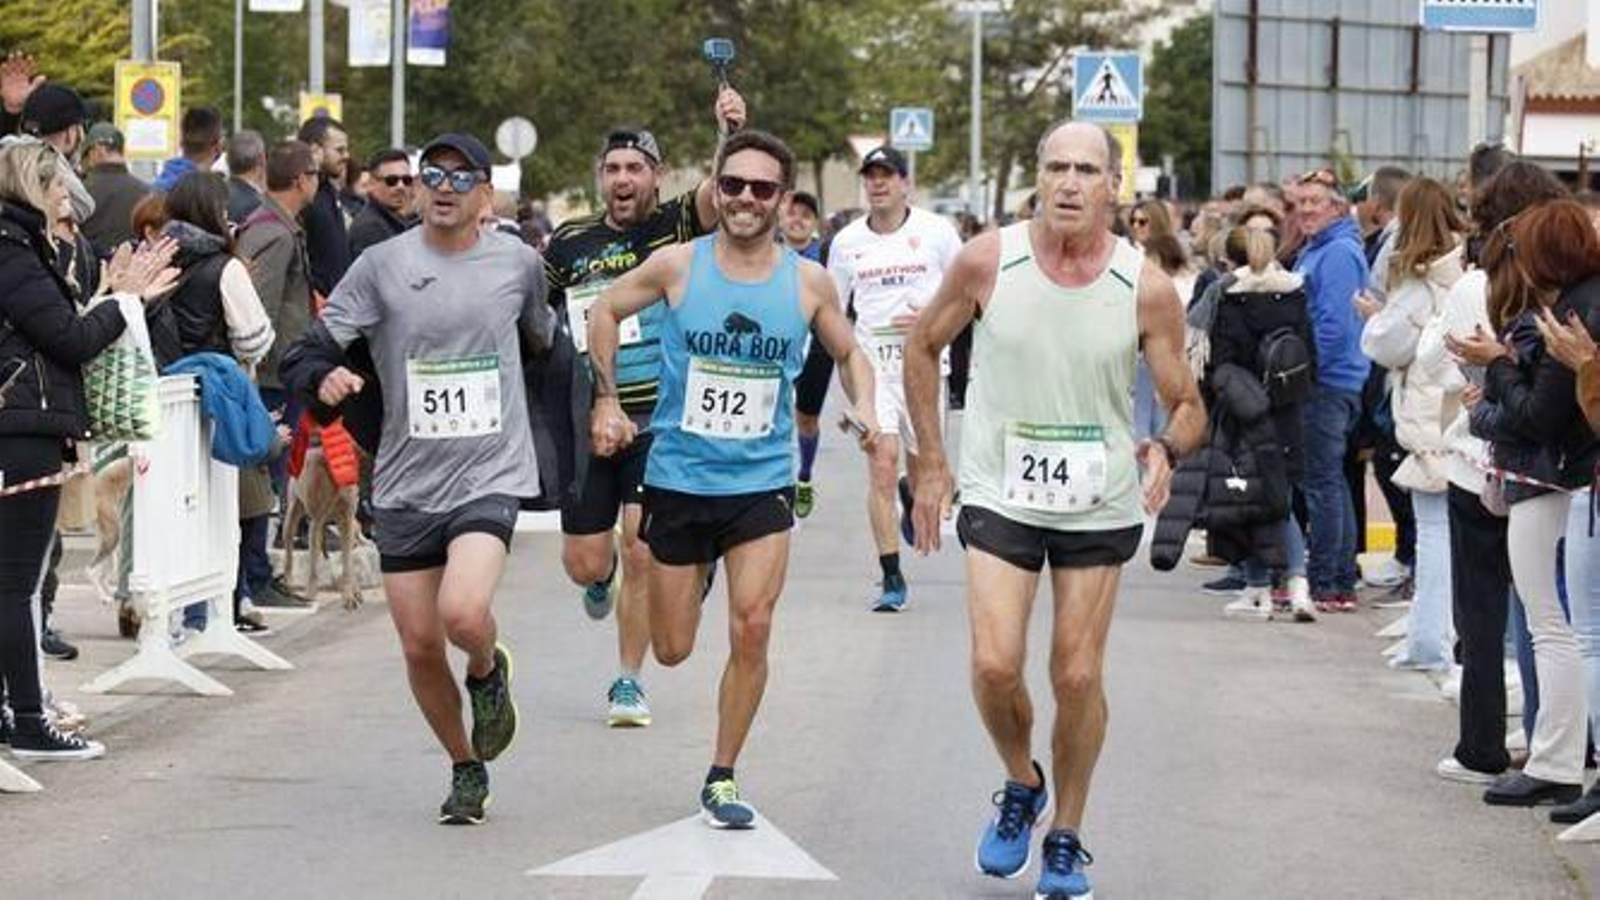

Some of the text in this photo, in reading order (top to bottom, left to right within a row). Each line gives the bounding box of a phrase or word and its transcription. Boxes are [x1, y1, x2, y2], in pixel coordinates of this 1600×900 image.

[857, 264, 928, 279] MARATHON
[684, 329, 792, 361] KORA BOX
[423, 387, 466, 415] 511
[701, 387, 747, 416] 512
[1021, 454, 1070, 485] 214
